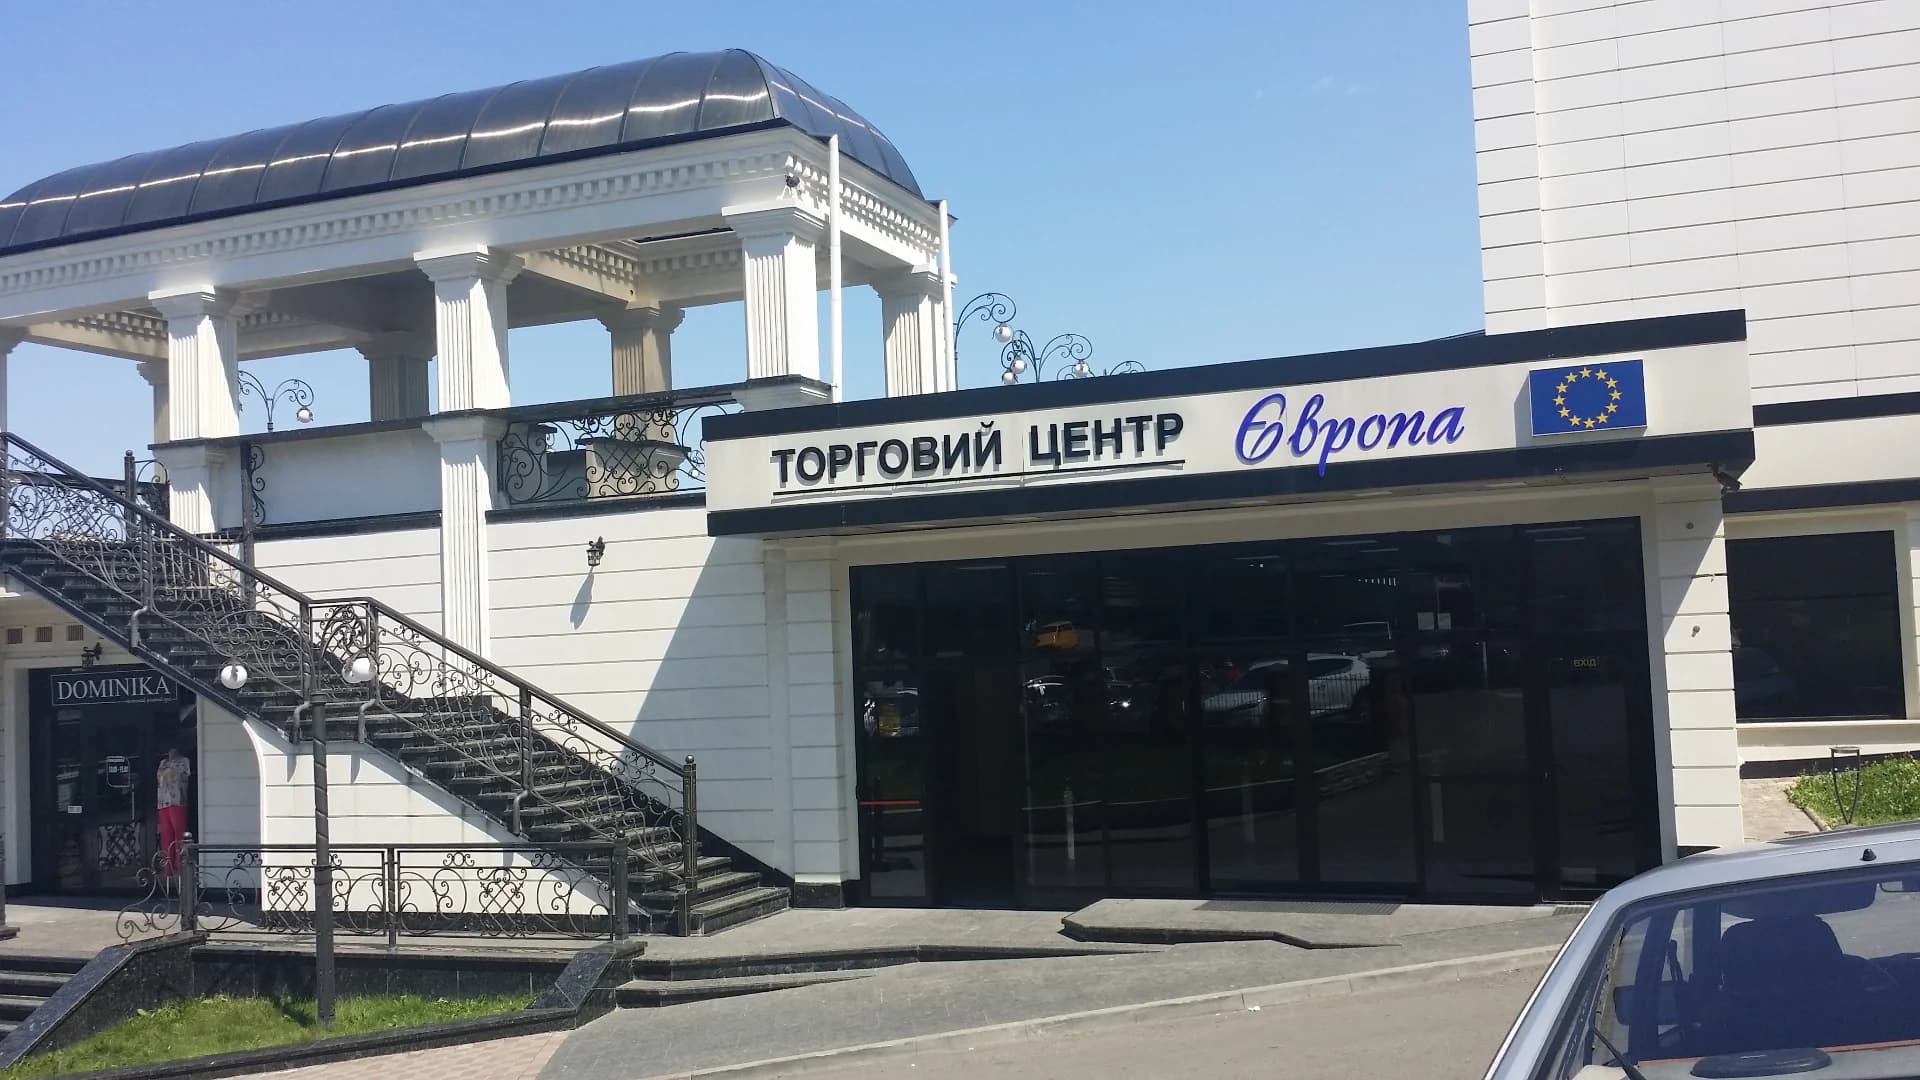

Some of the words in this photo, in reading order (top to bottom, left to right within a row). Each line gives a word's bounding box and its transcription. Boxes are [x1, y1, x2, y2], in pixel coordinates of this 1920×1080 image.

[771, 420, 1002, 488] ТОРГОВИЙ
[1030, 412, 1184, 467] ЦЕНТР
[1236, 394, 1464, 475] Європа
[56, 676, 170, 699] DOMINIKA
